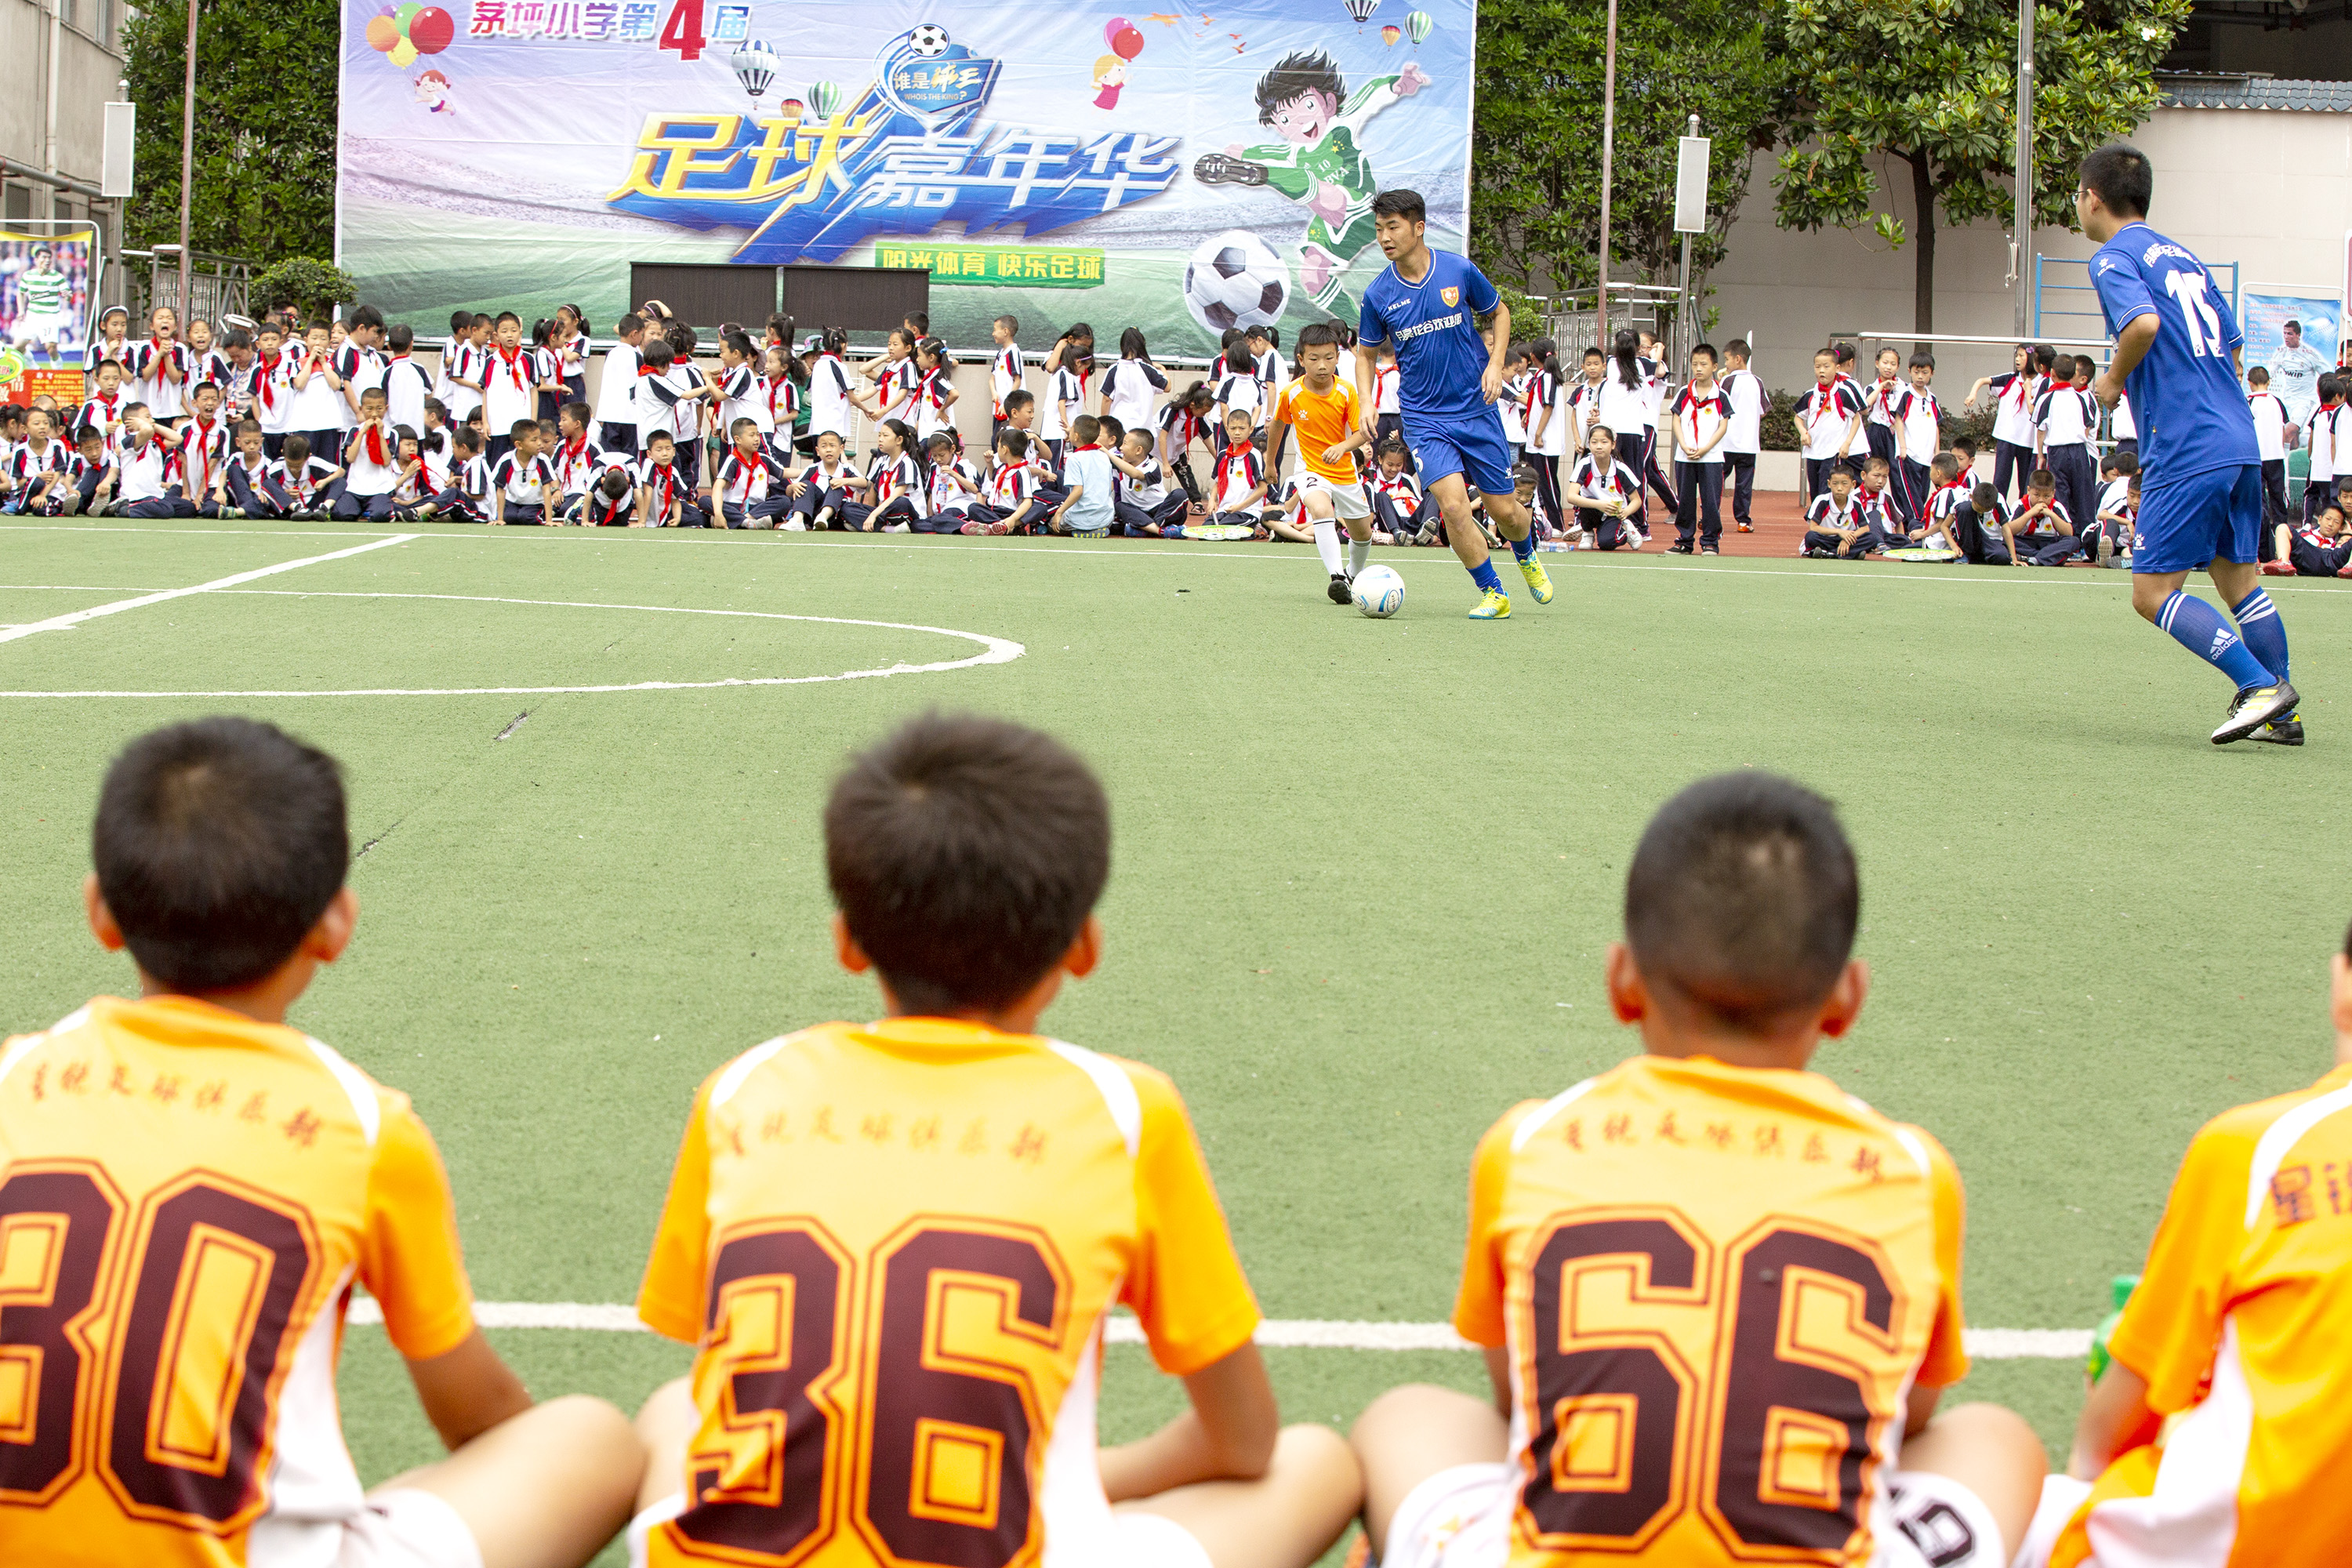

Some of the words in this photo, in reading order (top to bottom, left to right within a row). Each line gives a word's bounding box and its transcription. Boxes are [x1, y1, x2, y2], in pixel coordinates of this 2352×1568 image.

[470, 0, 750, 61] 茅坪小学第4届
[605, 111, 1182, 214] 足球嘉年华
[1318, 159, 1331, 172] 10
[884, 249, 985, 275] 阳光体育
[998, 253, 1100, 279] 快乐足球
[1388, 299, 1411, 311] KELME
[2165, 270, 2224, 358] 15
[1411, 448, 1424, 473] 5
[1306, 477, 1318, 488] 2
[2212, 635, 2239, 660] adidas
[666, 1213, 1074, 1568] 36
[1511, 1204, 1909, 1568] 66
